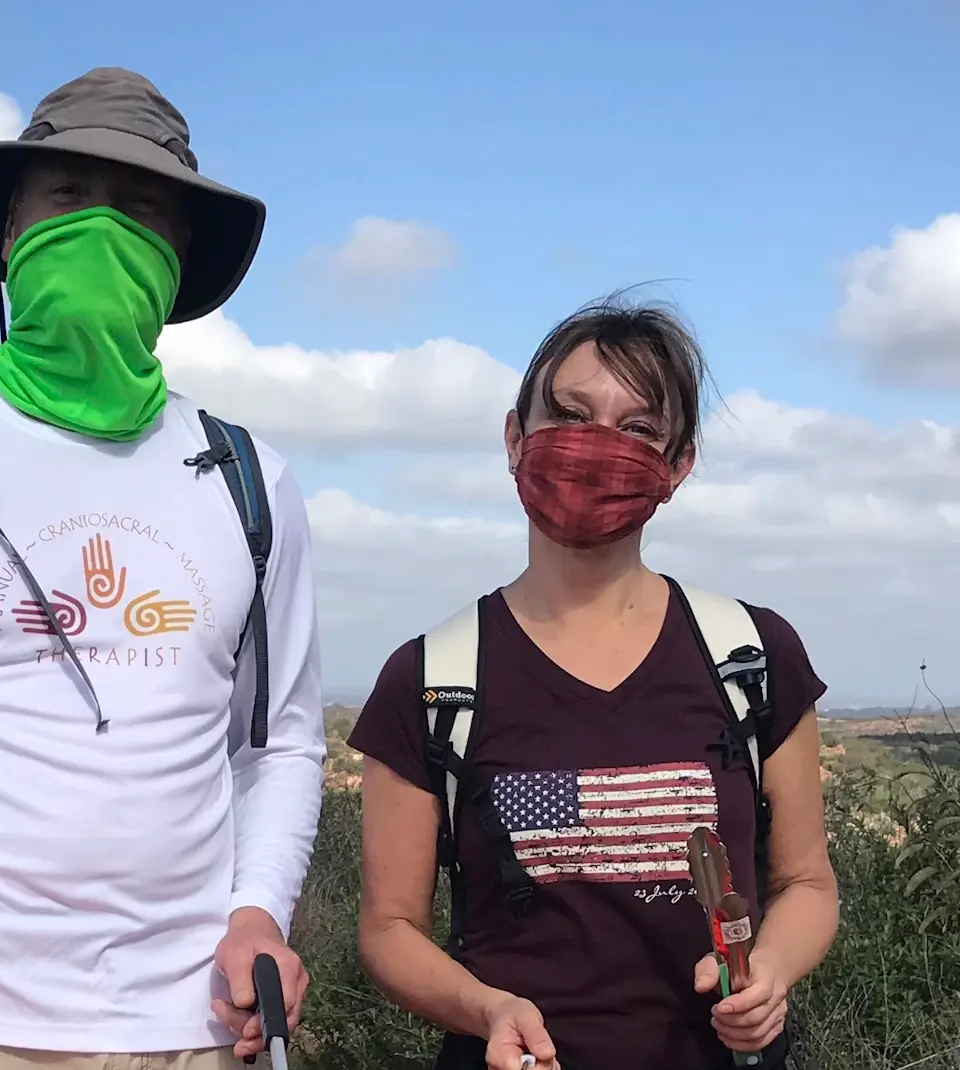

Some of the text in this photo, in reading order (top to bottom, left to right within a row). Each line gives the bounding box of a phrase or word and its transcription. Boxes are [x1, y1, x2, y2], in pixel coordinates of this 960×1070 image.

[38, 512, 161, 544] CRANIOSACRAL
[175, 551, 216, 637] MASSAGE
[645, 884, 686, 904] July
